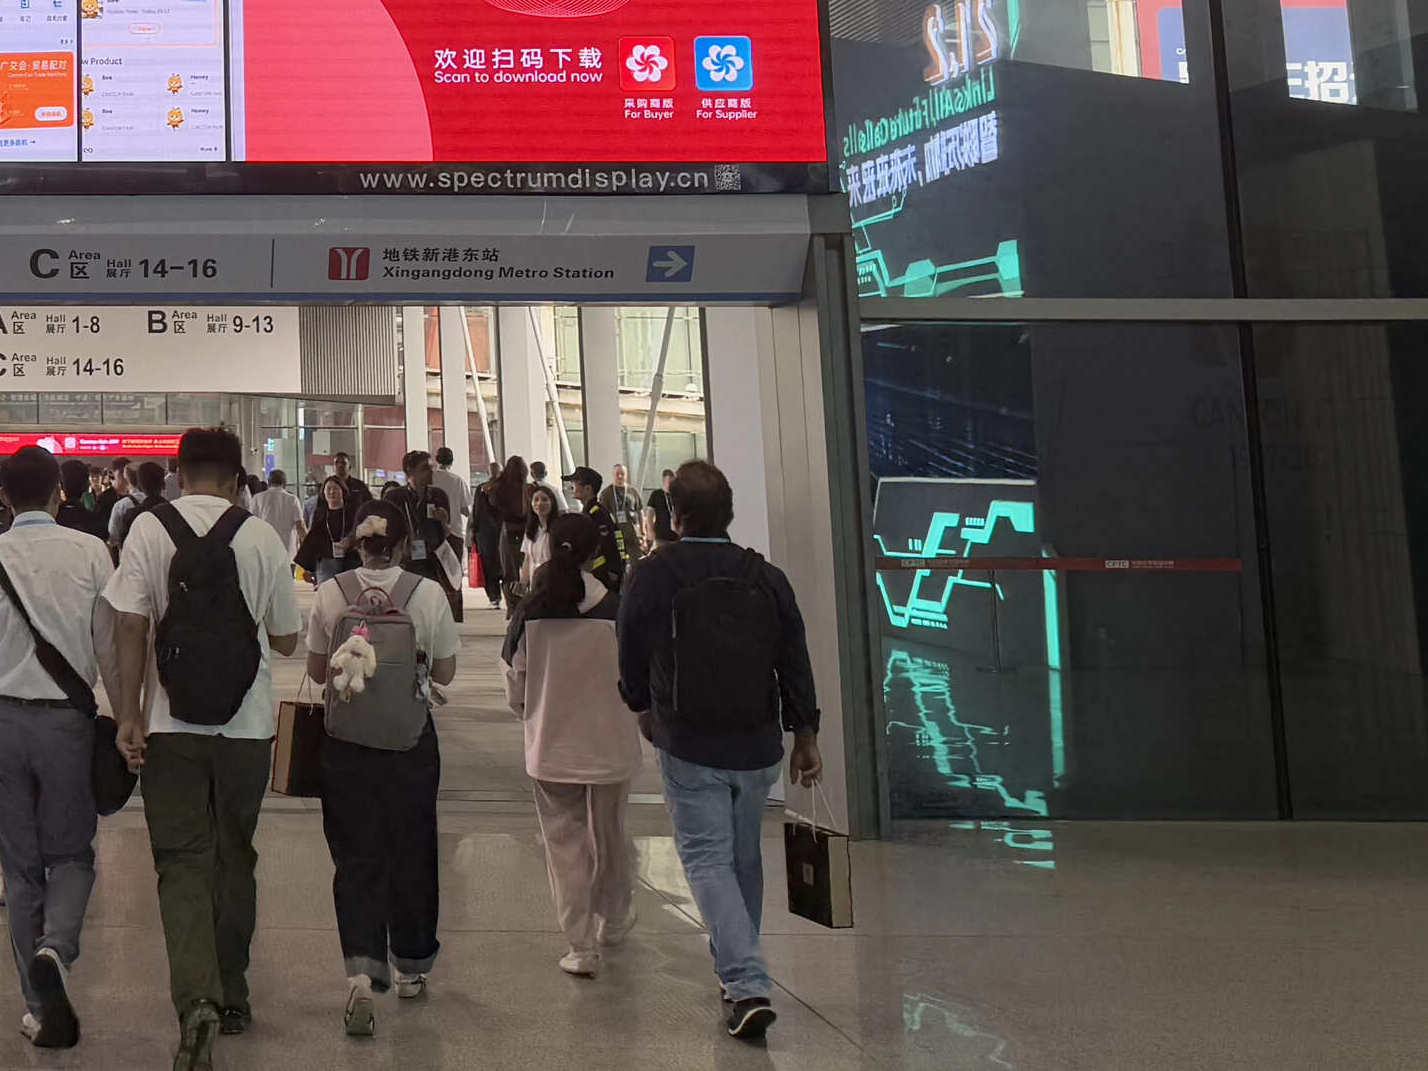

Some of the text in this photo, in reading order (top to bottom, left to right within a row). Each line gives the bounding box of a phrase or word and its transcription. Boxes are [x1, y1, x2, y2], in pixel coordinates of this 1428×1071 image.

[91, 57, 123, 66] Product
[434, 48, 602, 70] 欢迎扫码下载
[434, 70, 603, 84] Scan to download now
[624, 110, 674, 121] For Buyer
[696, 110, 758, 121] For Supplier
[360, 169, 709, 193] www.spectrumdisplay.cn
[383, 247, 500, 262] 地铁新港东站
[29, 248, 217, 279] C Area 区 Hall 展厅 14-16
[383, 265, 615, 280] Xingangdong Metro Station
[11, 311, 37, 320] Area
[45, 314, 66, 323] Hall
[147, 310, 274, 333] B Area 区 Hall 展厅 9-13
[13, 321, 25, 334] 区
[45, 324, 66, 334] 展厅
[72, 315, 100, 333] 1-8
[11, 353, 37, 362] Area
[46, 357, 66, 365] Hall
[13, 363, 26, 377] 区
[45, 366, 67, 376] 展厅
[72, 358, 124, 376] 14-16
